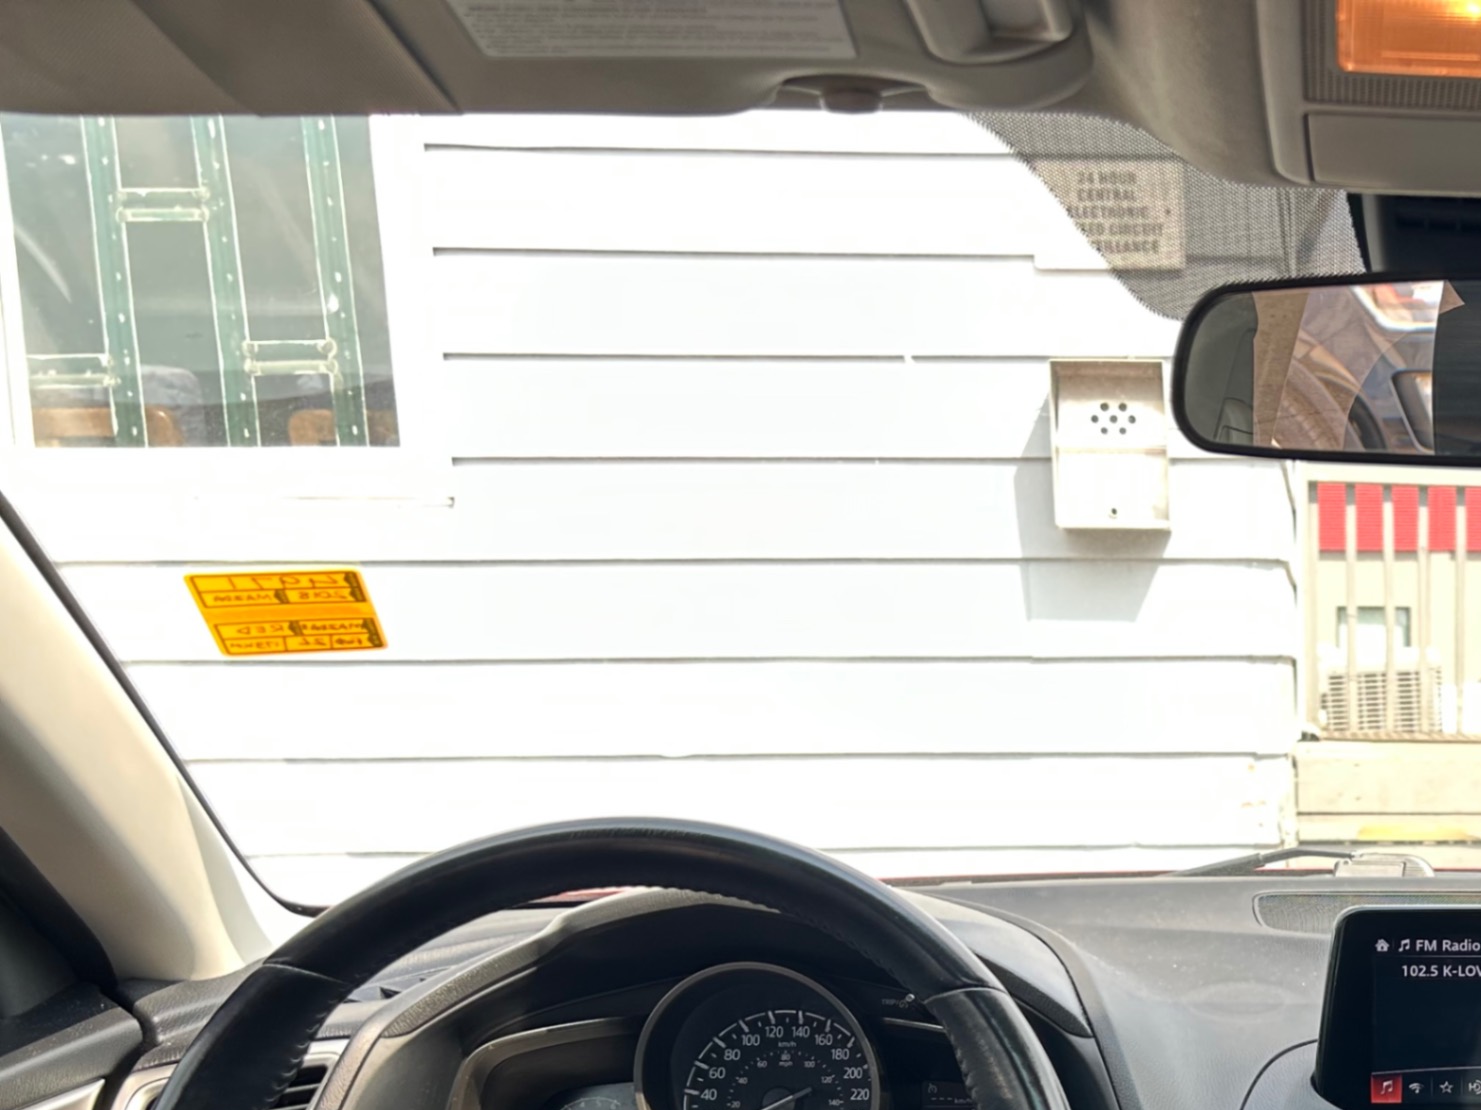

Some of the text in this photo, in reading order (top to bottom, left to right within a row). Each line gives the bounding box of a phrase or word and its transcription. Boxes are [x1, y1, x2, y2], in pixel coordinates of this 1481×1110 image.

[1076, 171, 1137, 184] 24 HOUR
[1076, 188, 1137, 202] CENTRAL
[1109, 223, 1164, 237] CIRCUIT
[1415, 938, 1481, 952] FM Radio
[1401, 965, 1439, 978] 102.5
[765, 1026, 784, 1038] 120
[791, 1026, 810, 1038] 140
[741, 1034, 760, 1046] 100
[778, 1040, 797, 1048] km/h
[815, 1034, 833, 1046] 160
[724, 1049, 741, 1061] 80
[831, 1049, 849, 1060] 180
[708, 1067, 726, 1079] 60
[843, 1067, 862, 1079] 200
[700, 1088, 718, 1100] 40
[850, 1088, 869, 1100] 220
